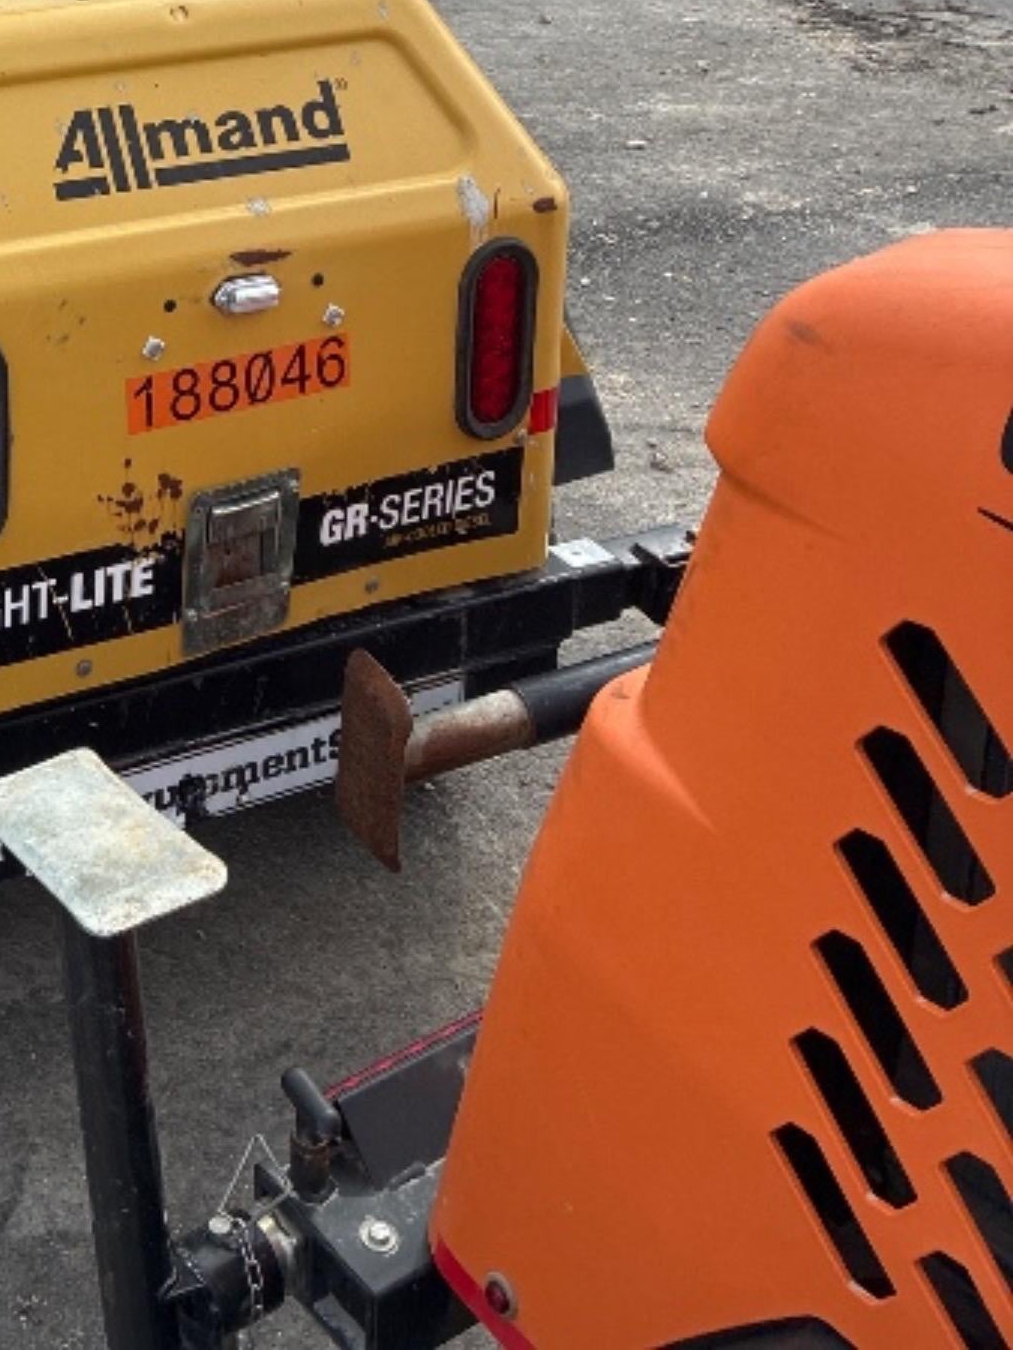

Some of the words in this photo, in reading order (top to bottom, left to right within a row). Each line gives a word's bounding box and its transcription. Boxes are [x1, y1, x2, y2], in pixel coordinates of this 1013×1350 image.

[54, 78, 346, 192] Allmand
[133, 334, 346, 427] 188046
[320, 470, 496, 547] GR-SERIES
